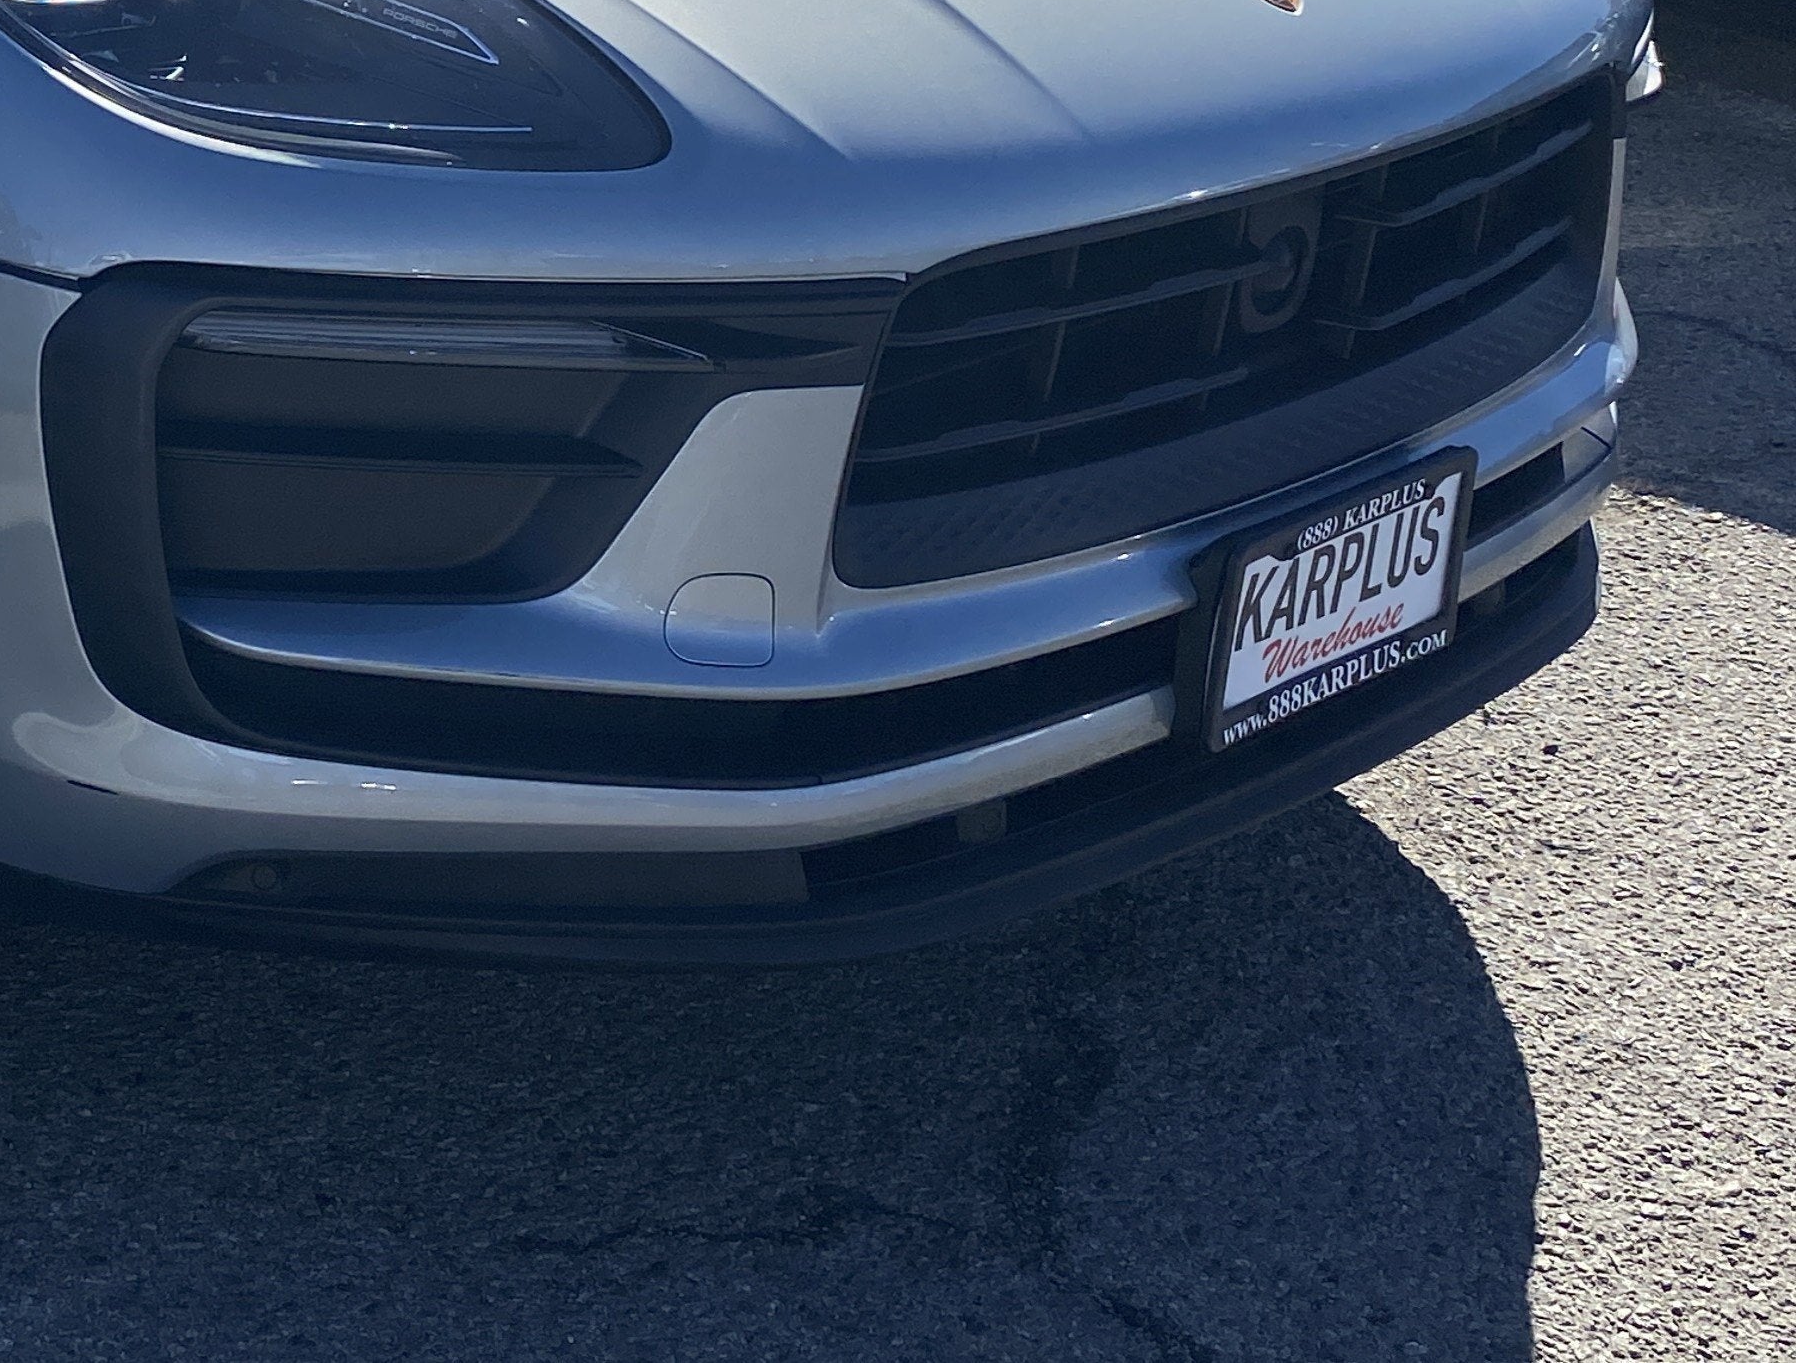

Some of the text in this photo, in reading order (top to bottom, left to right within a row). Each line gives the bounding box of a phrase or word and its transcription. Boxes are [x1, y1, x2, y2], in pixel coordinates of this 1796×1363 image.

[382, 7, 459, 39] PORSCHE
[1297, 478, 1427, 551] (888) KARPLUS
[1234, 495, 1446, 652] KARPLUS
[1261, 601, 1405, 684] Warehouse
